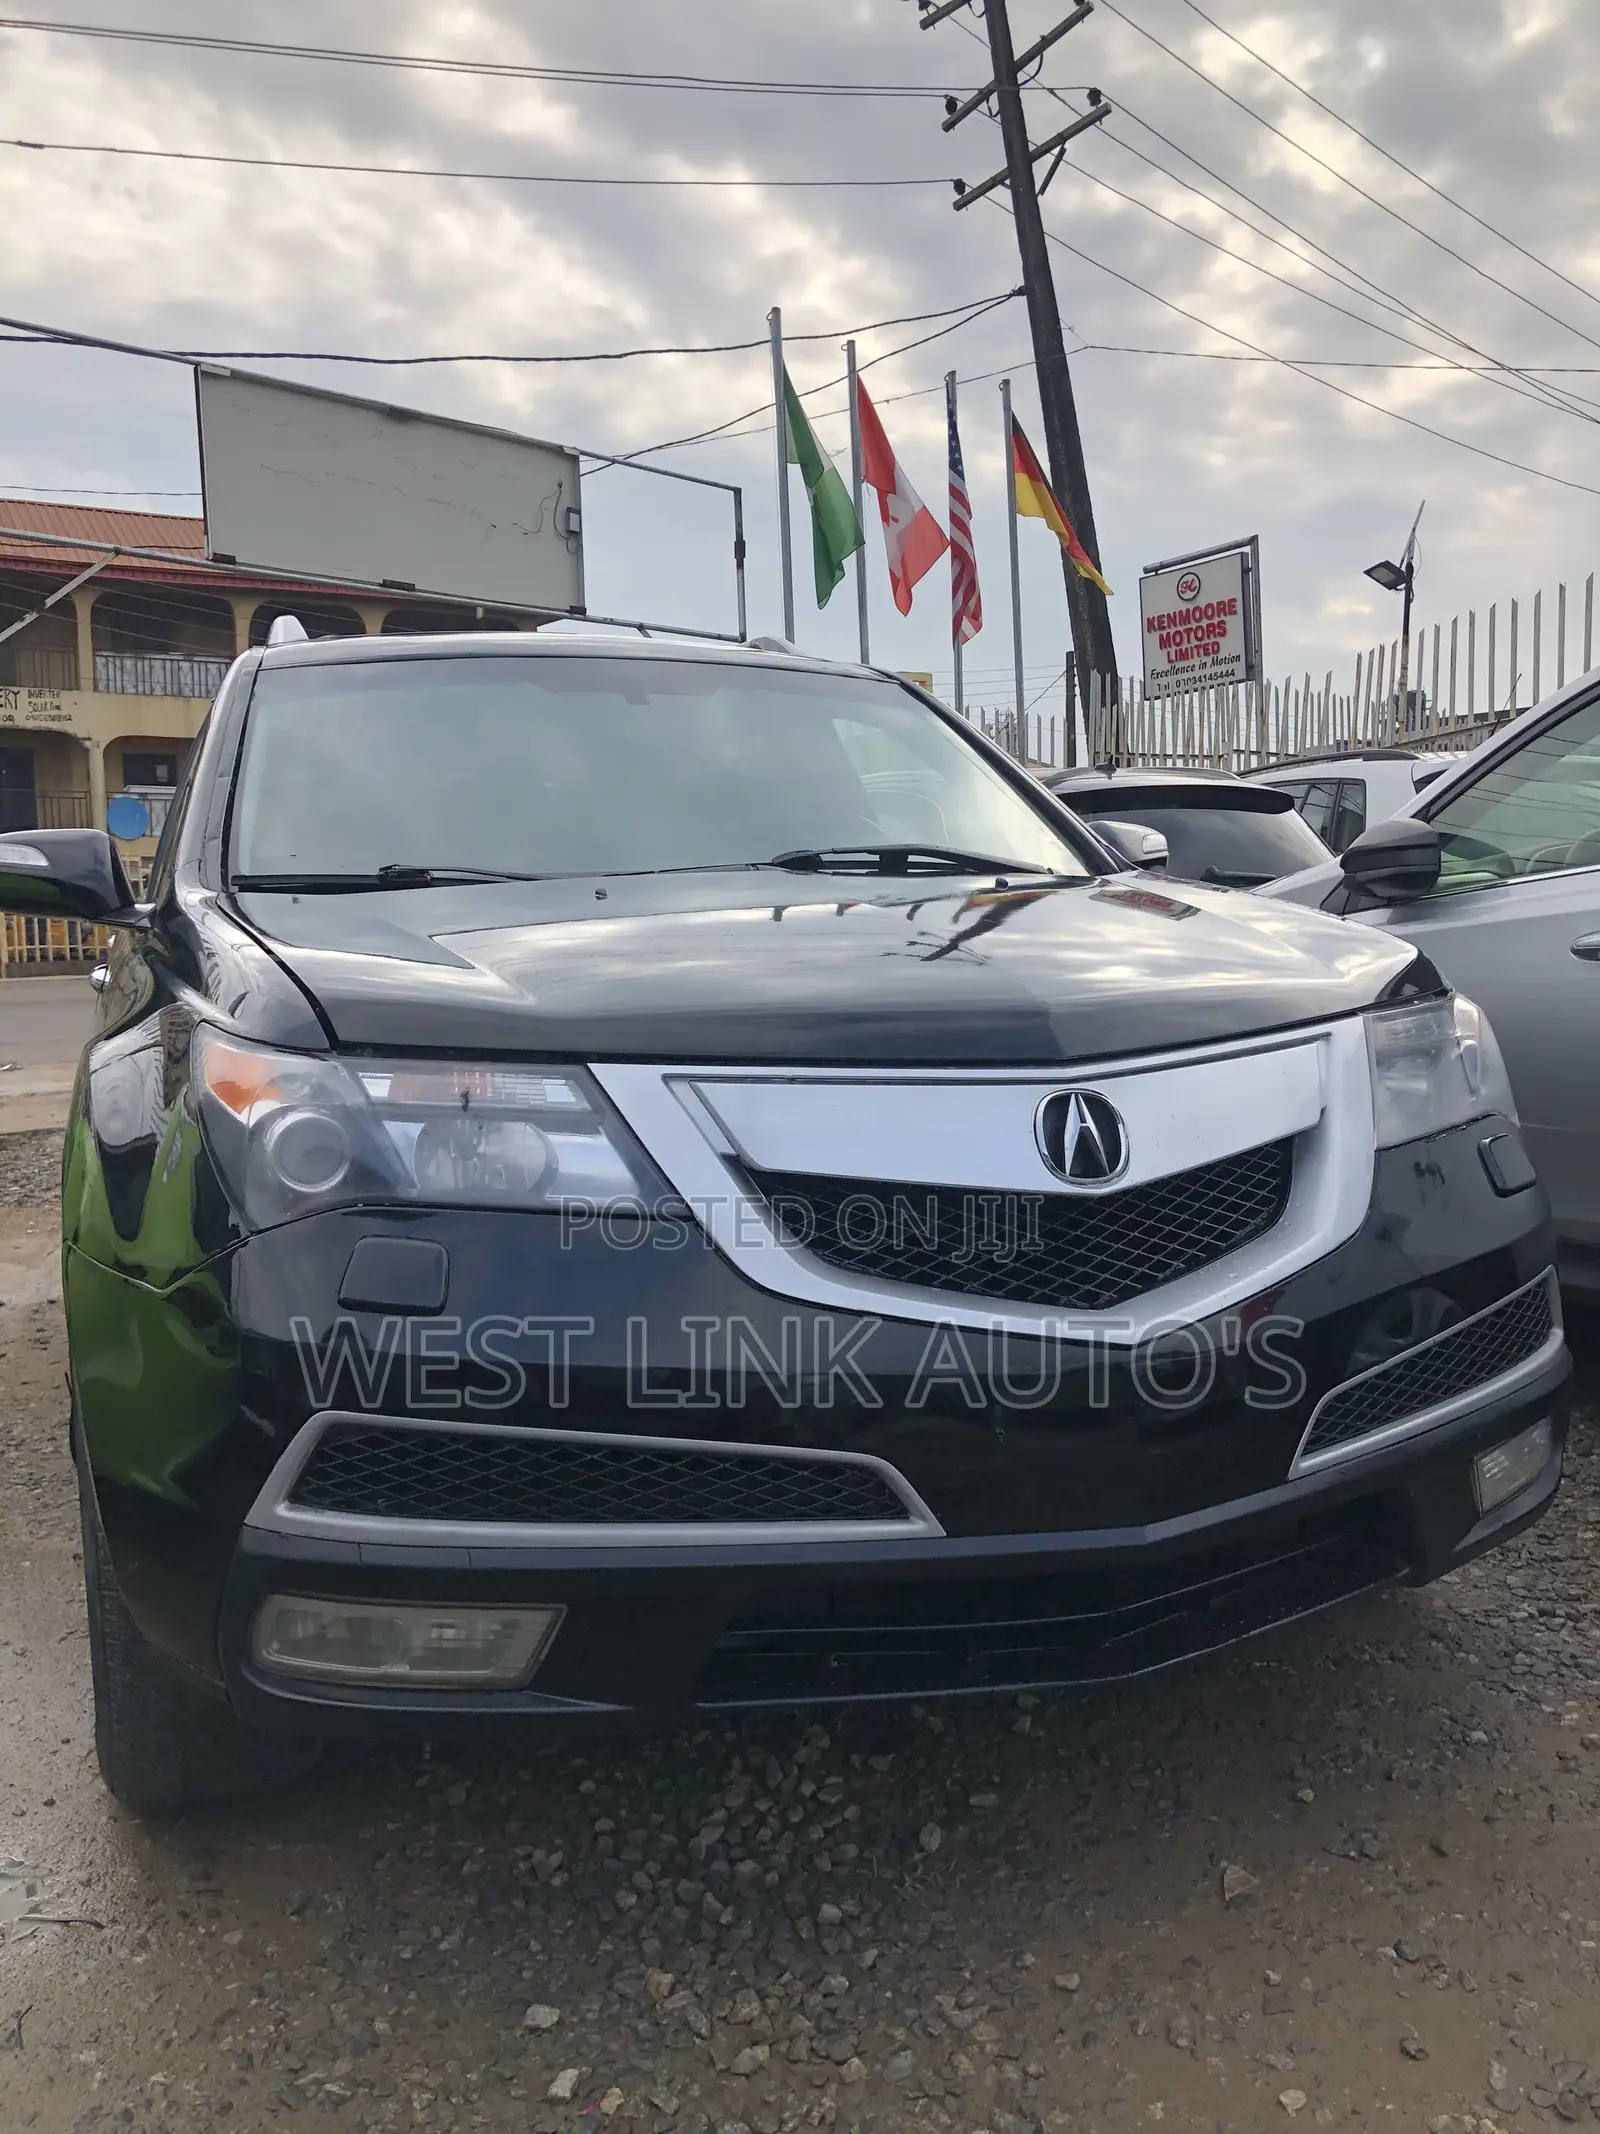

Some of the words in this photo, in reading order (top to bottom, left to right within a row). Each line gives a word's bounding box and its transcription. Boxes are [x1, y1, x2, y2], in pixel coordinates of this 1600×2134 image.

[1146, 598, 1238, 633] KENMOORE
[1158, 620, 1227, 650] MOTORS
[1167, 640, 1221, 664] LIMITED
[1150, 664, 1196, 680] Excellence
[1198, 660, 1207, 670] in
[1209, 653, 1241, 668] Motion
